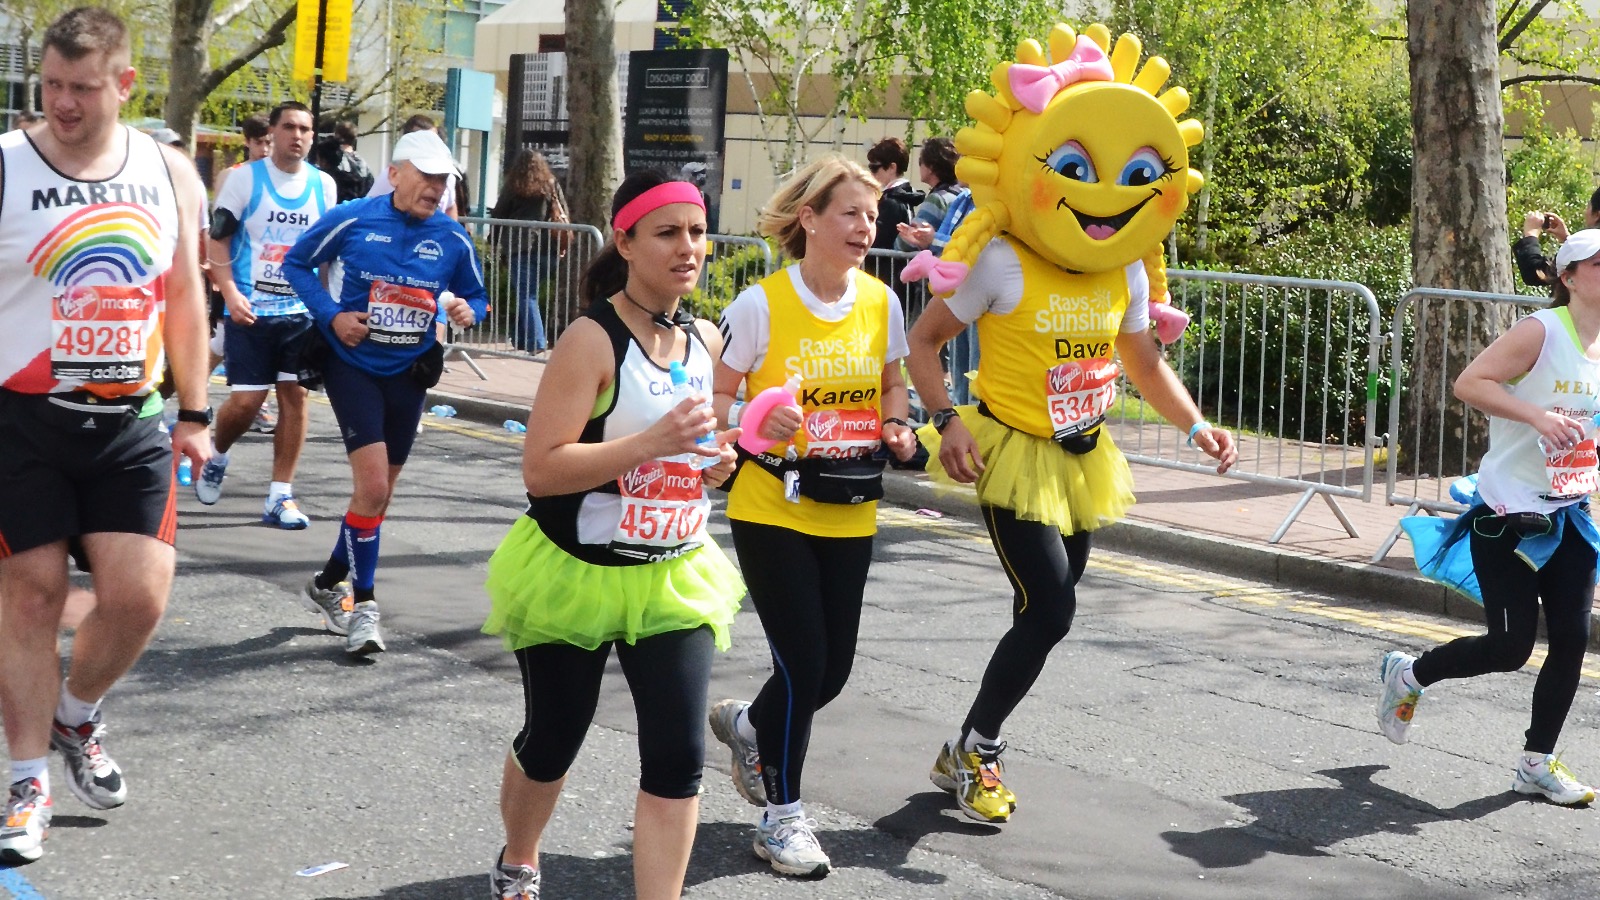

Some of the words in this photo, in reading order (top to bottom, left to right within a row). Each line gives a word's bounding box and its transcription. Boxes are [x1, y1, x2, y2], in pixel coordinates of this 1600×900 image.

[649, 73, 683, 83] DISCOVERY
[685, 73, 706, 83] DOCK
[32, 182, 159, 211] MARTIN
[267, 210, 309, 226] JOSH
[1049, 294, 1090, 313] Rays
[369, 307, 431, 329] 58443
[1034, 308, 1123, 333] Sunshine
[56, 326, 142, 356] 49281
[800, 338, 846, 358] Rays
[1055, 338, 1110, 359] Dave
[92, 365, 141, 380] adidas
[1052, 364, 1081, 392] Virgin
[649, 375, 704, 396] CAHY
[802, 387, 877, 407] Karen
[810, 414, 839, 439] Virgin
[625, 467, 663, 497] Virgin
[620, 504, 703, 541] 45702
